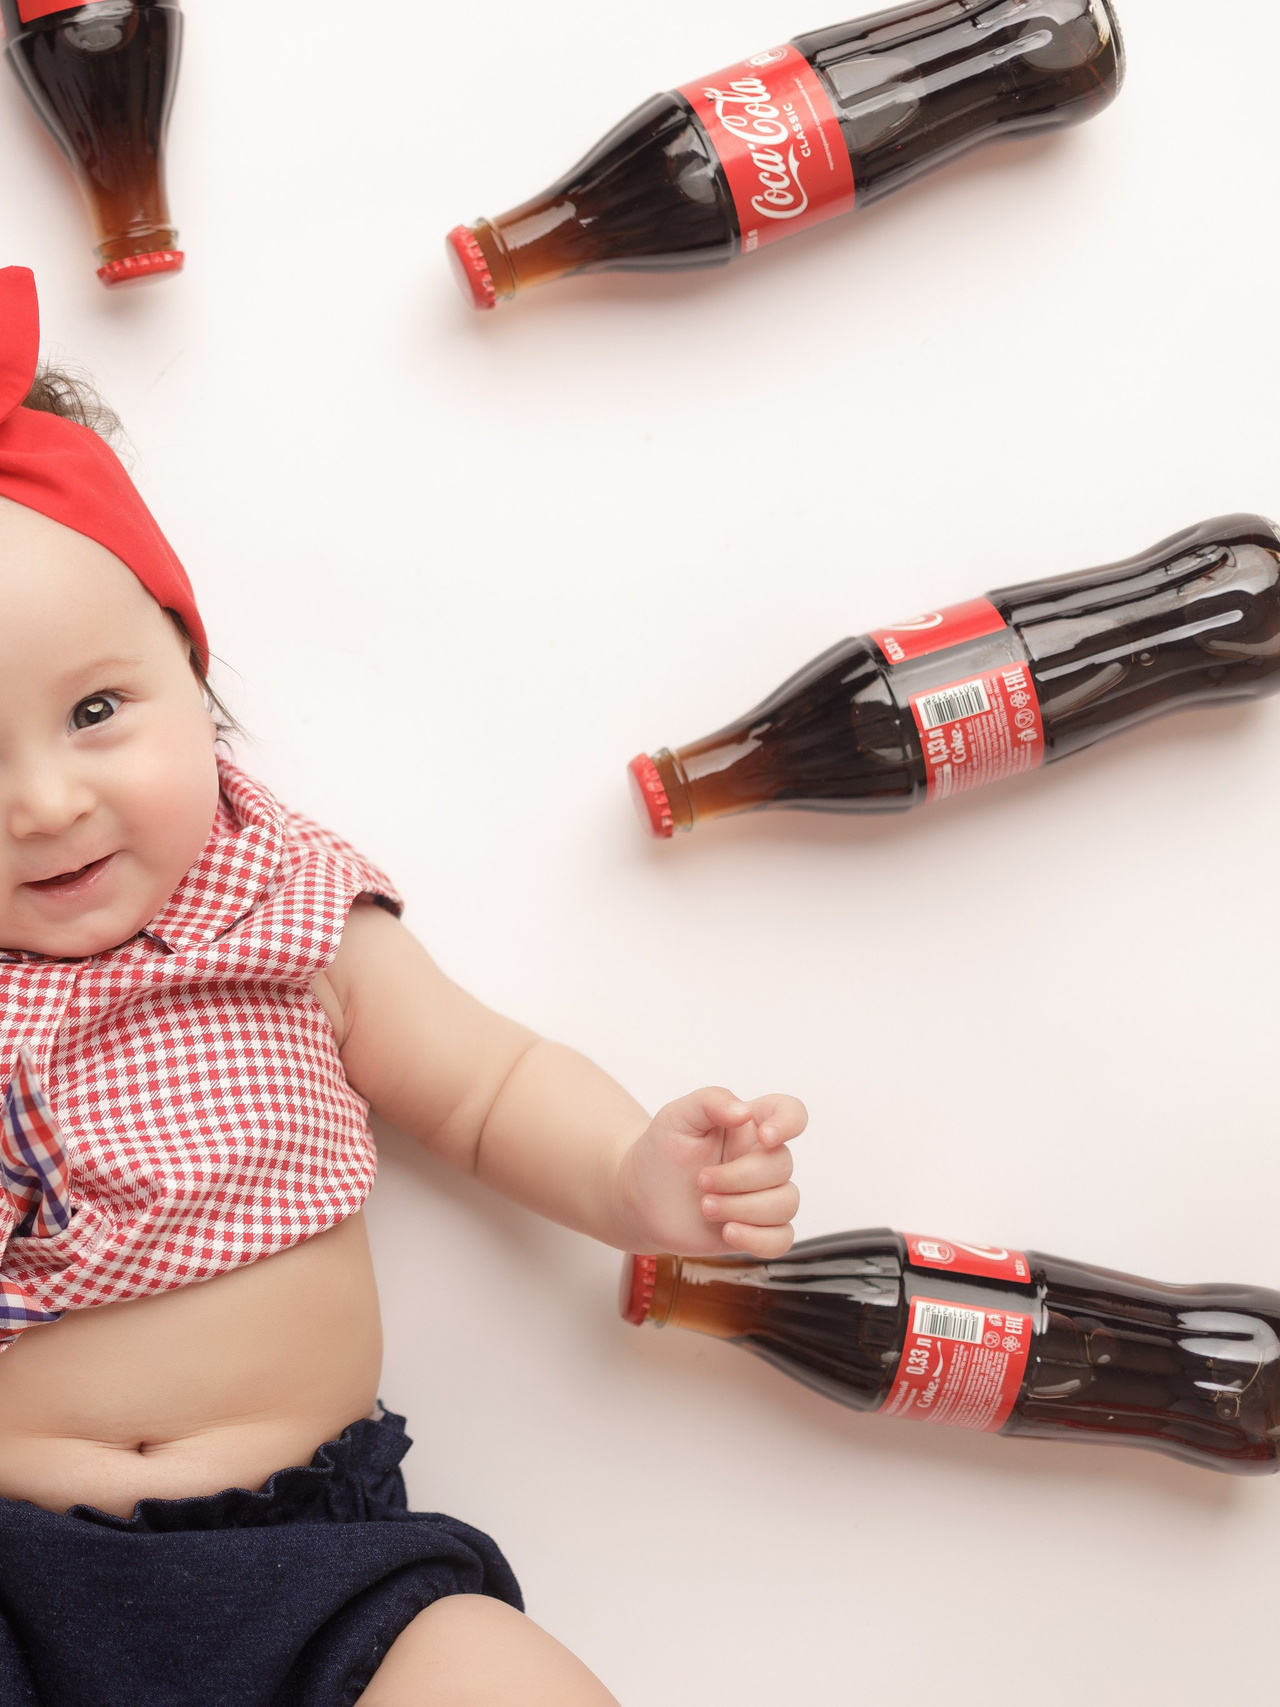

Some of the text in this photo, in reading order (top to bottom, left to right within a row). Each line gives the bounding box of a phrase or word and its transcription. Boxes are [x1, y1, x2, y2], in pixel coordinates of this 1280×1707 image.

[783, 102, 811, 157] CLASSIC
[701, 77, 808, 219] Coca-Cola
[927, 738, 951, 764] 0,33
[951, 728, 966, 763] Coke
[906, 1349, 930, 1375] 0,33
[916, 1381, 938, 1408] Coke
